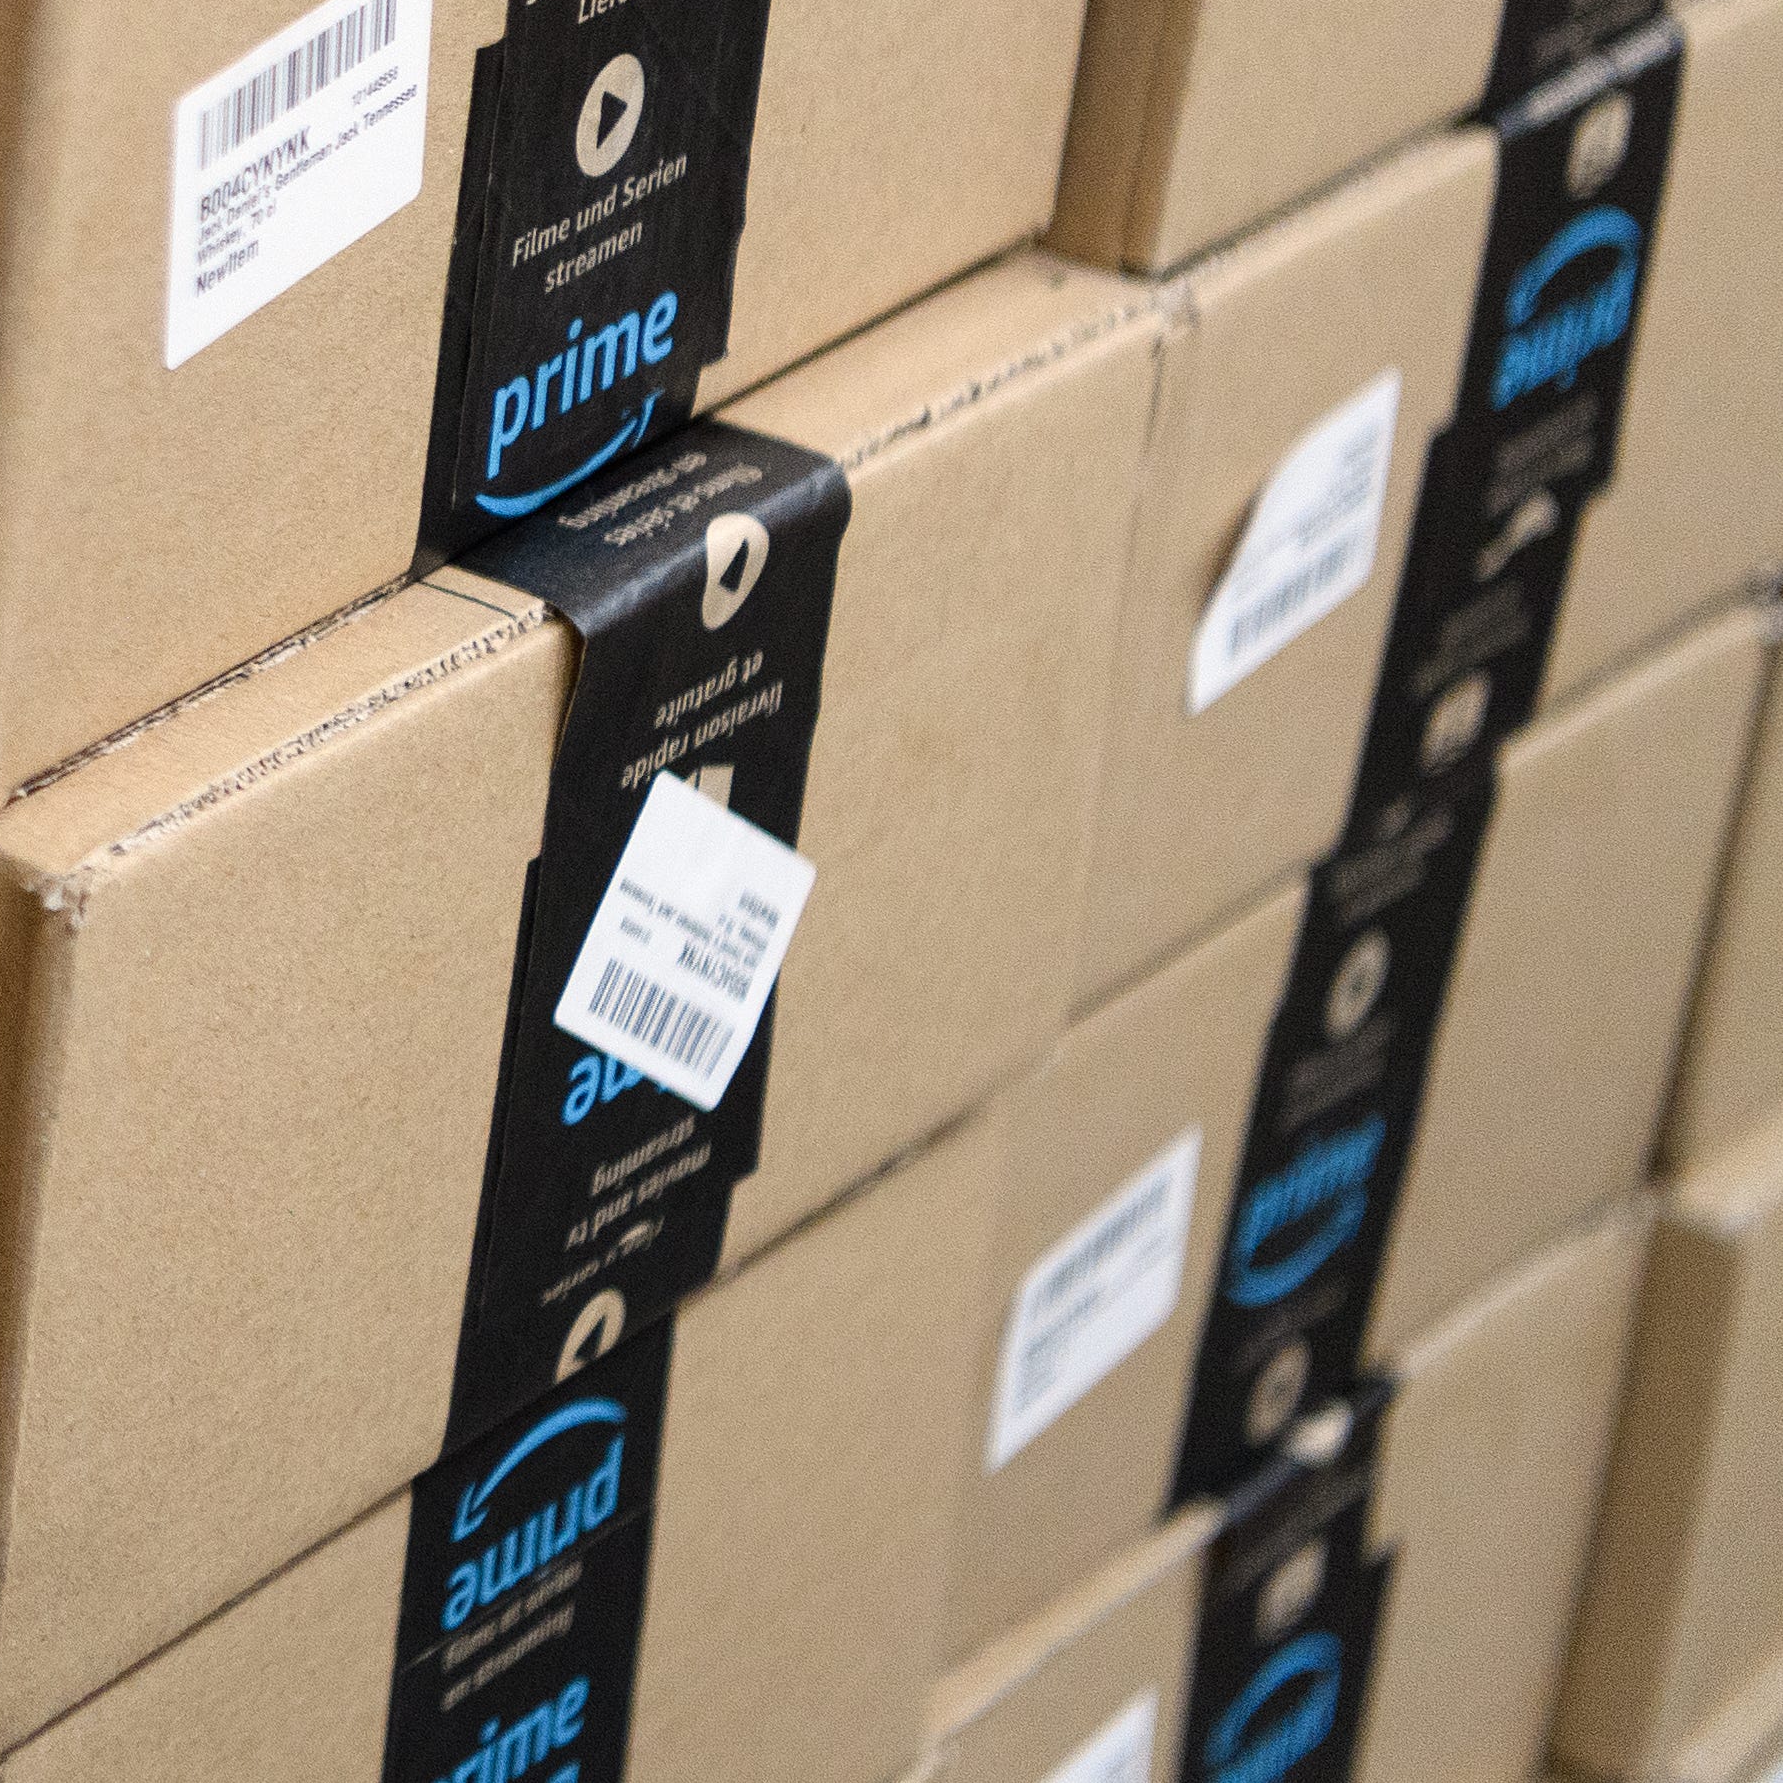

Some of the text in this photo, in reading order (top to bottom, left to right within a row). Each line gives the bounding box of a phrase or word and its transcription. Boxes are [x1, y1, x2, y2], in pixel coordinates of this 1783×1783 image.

[274, 143, 333, 191] Gentleman
[335, 120, 360, 150] Jack
[513, 154, 687, 268] Filme und Serien
[544, 220, 643, 294] streamen
[196, 239, 259, 298] NewItem
[485, 289, 679, 481] prime
[621, 680, 783, 790] livraison rapide
[654, 649, 764, 729] et gratuite
[440, 1432, 625, 1632] prime
